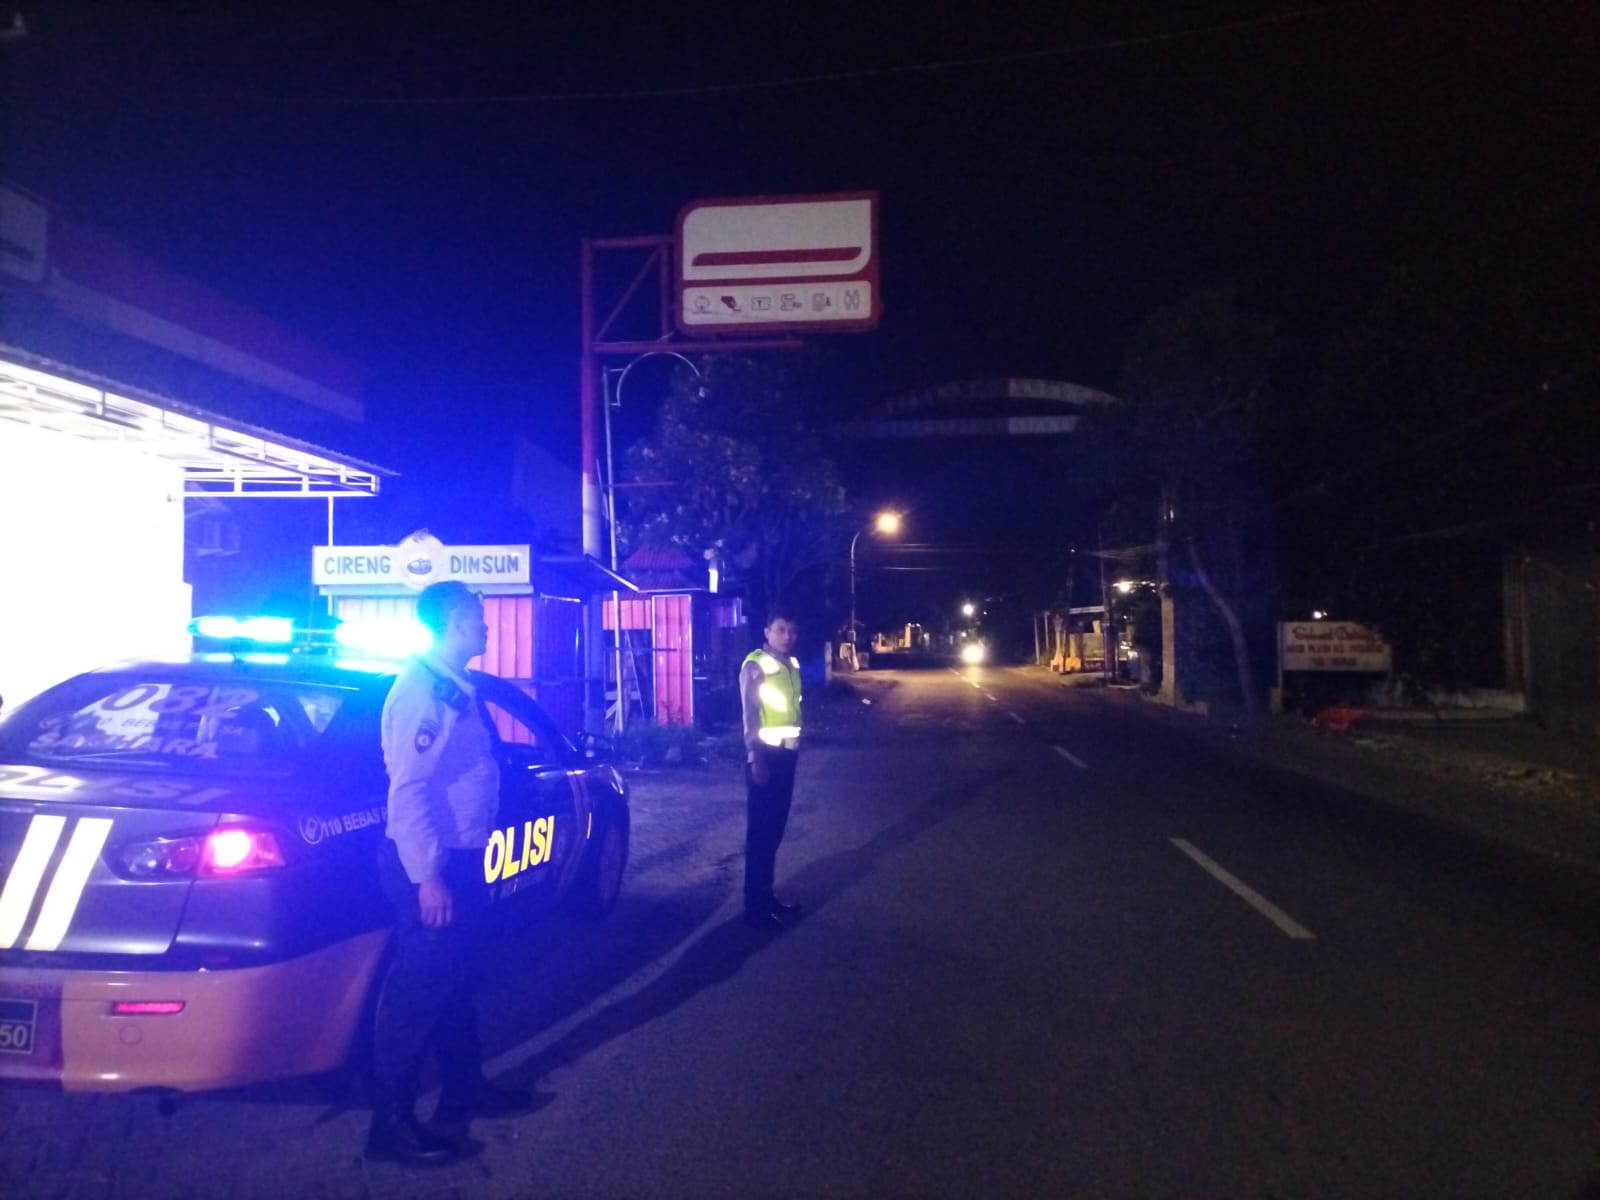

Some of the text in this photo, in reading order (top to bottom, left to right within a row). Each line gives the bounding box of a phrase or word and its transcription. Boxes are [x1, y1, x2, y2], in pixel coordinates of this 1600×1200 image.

[323, 554, 519, 575] CIRENG DIMSUM
[323, 816, 342, 837] 110
[342, 808, 380, 832] BEBAS
[484, 815, 555, 884] OLISI
